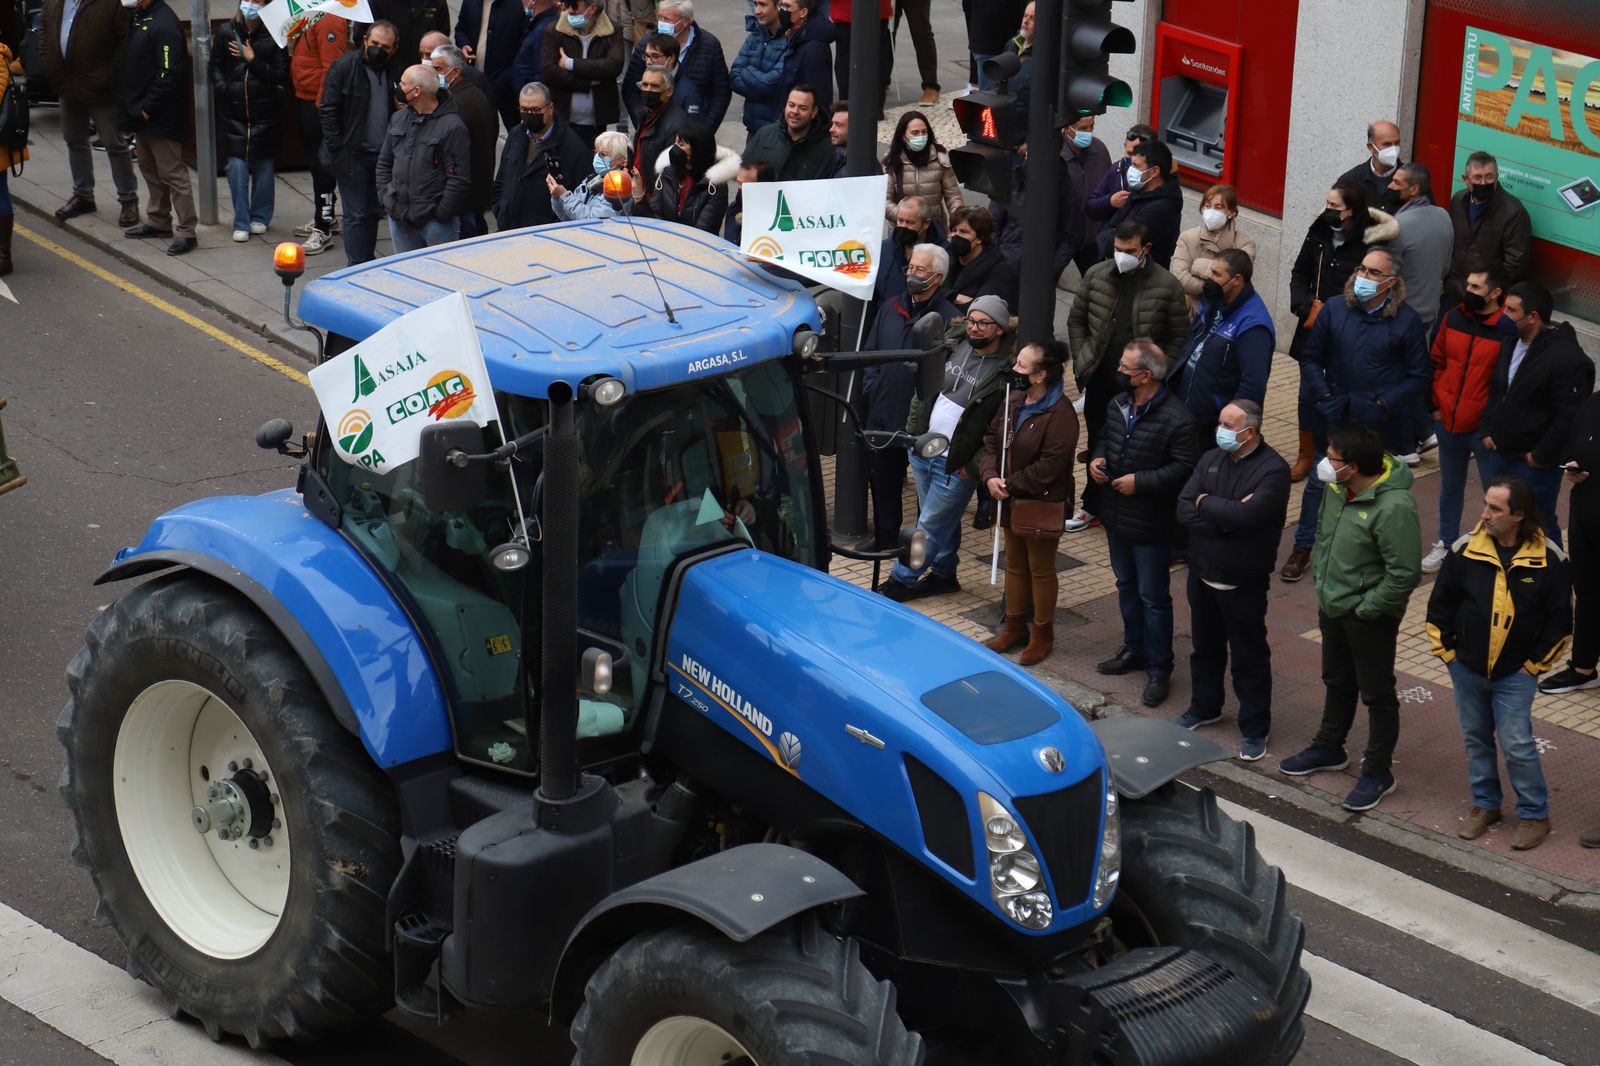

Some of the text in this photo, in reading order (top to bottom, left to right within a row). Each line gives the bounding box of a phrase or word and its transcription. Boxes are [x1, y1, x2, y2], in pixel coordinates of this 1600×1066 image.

[1190, 58, 1226, 76] Santander
[1461, 32, 1477, 112] ANTICIPA TU
[799, 248, 867, 268] COAG
[688, 349, 748, 374] ARGASA, S.L.
[951, 365, 983, 386] Colum
[386, 375, 465, 425] COAG
[682, 654, 773, 737] NEW HOLLAND
